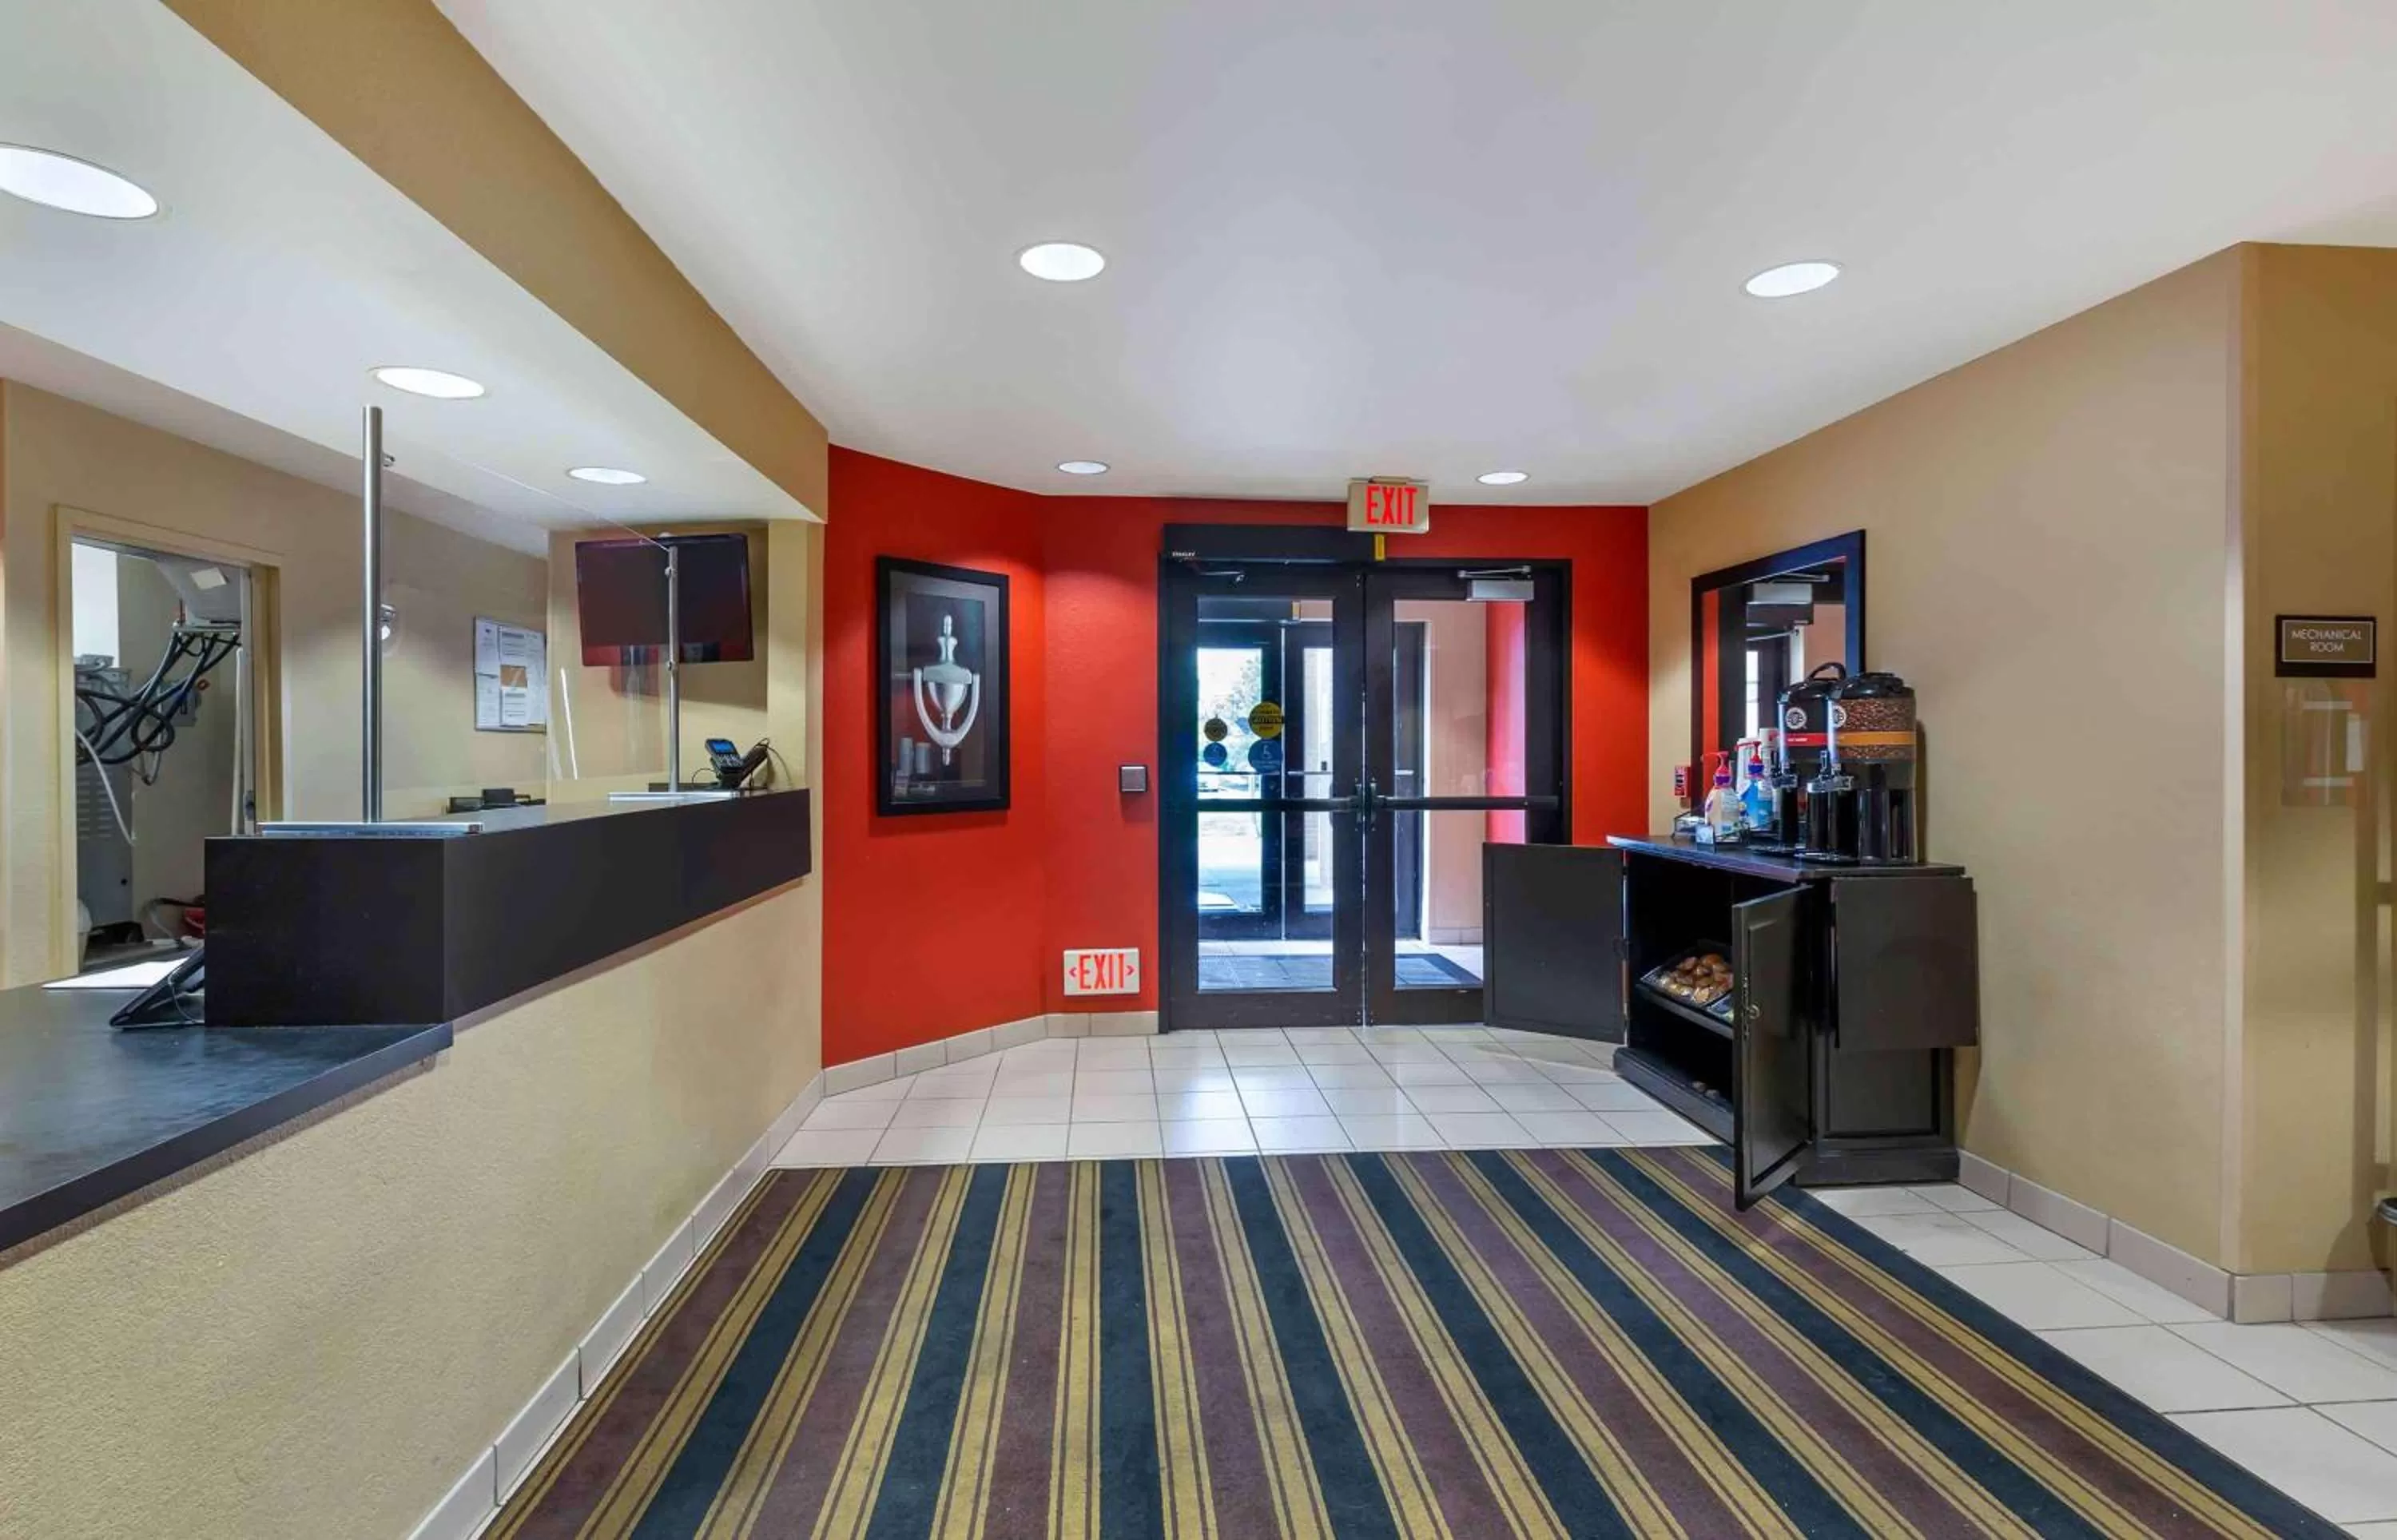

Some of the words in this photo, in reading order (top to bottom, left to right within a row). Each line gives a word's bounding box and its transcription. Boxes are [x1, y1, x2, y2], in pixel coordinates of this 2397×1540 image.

[1367, 485, 1417, 525] EXIT
[2290, 629, 2361, 640] MECHANICAL
[2310, 641, 2345, 653] ROOM
[1079, 953, 1124, 990] EXIT
